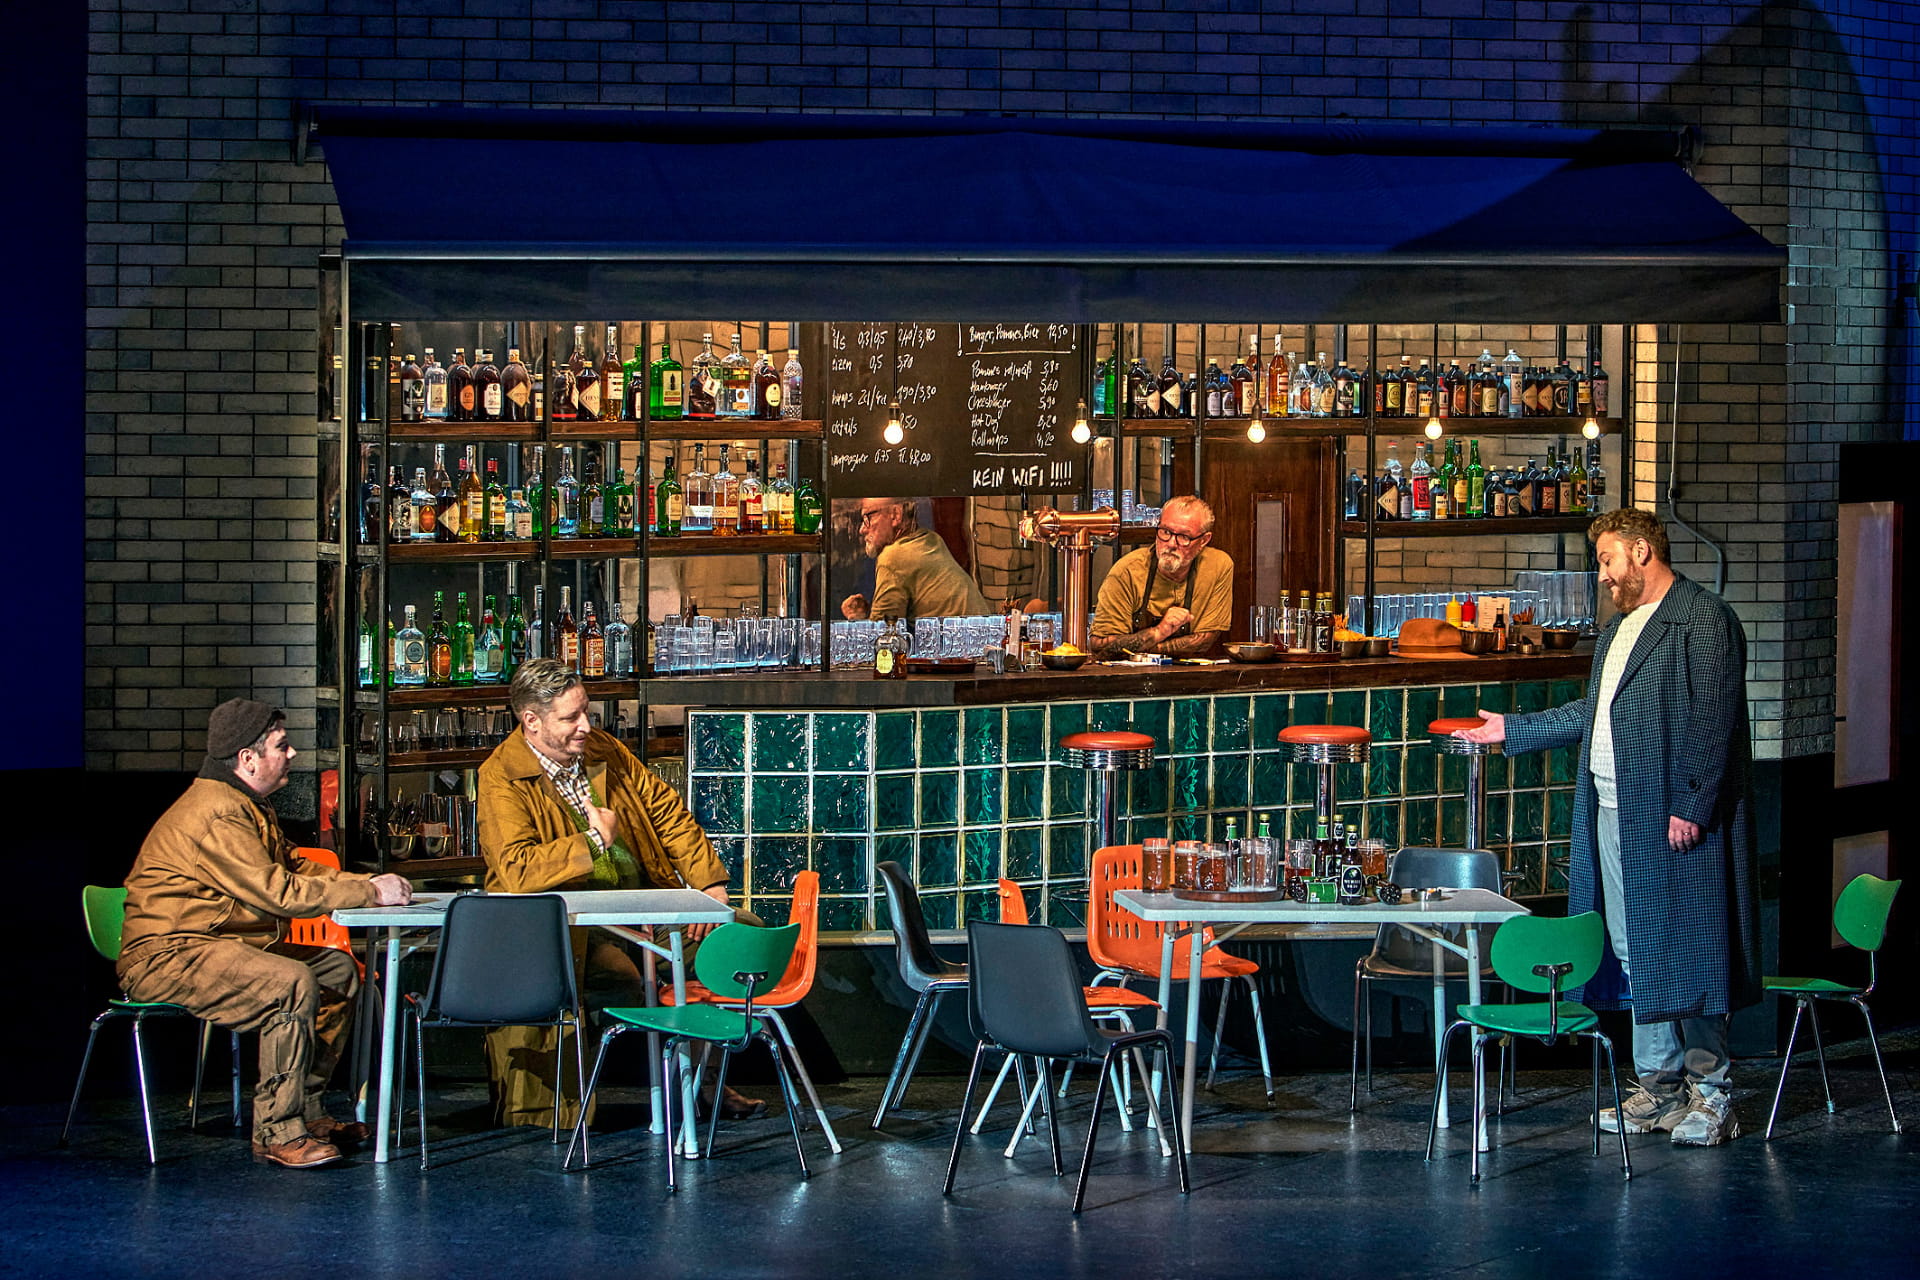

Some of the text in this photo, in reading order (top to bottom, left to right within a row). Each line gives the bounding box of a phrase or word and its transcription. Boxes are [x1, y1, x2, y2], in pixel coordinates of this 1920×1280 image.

[970, 380, 1008, 399] Hamburger
[971, 413, 985, 428] Hot
[984, 413, 999, 434] Dog
[972, 466, 1005, 489] KEIN
